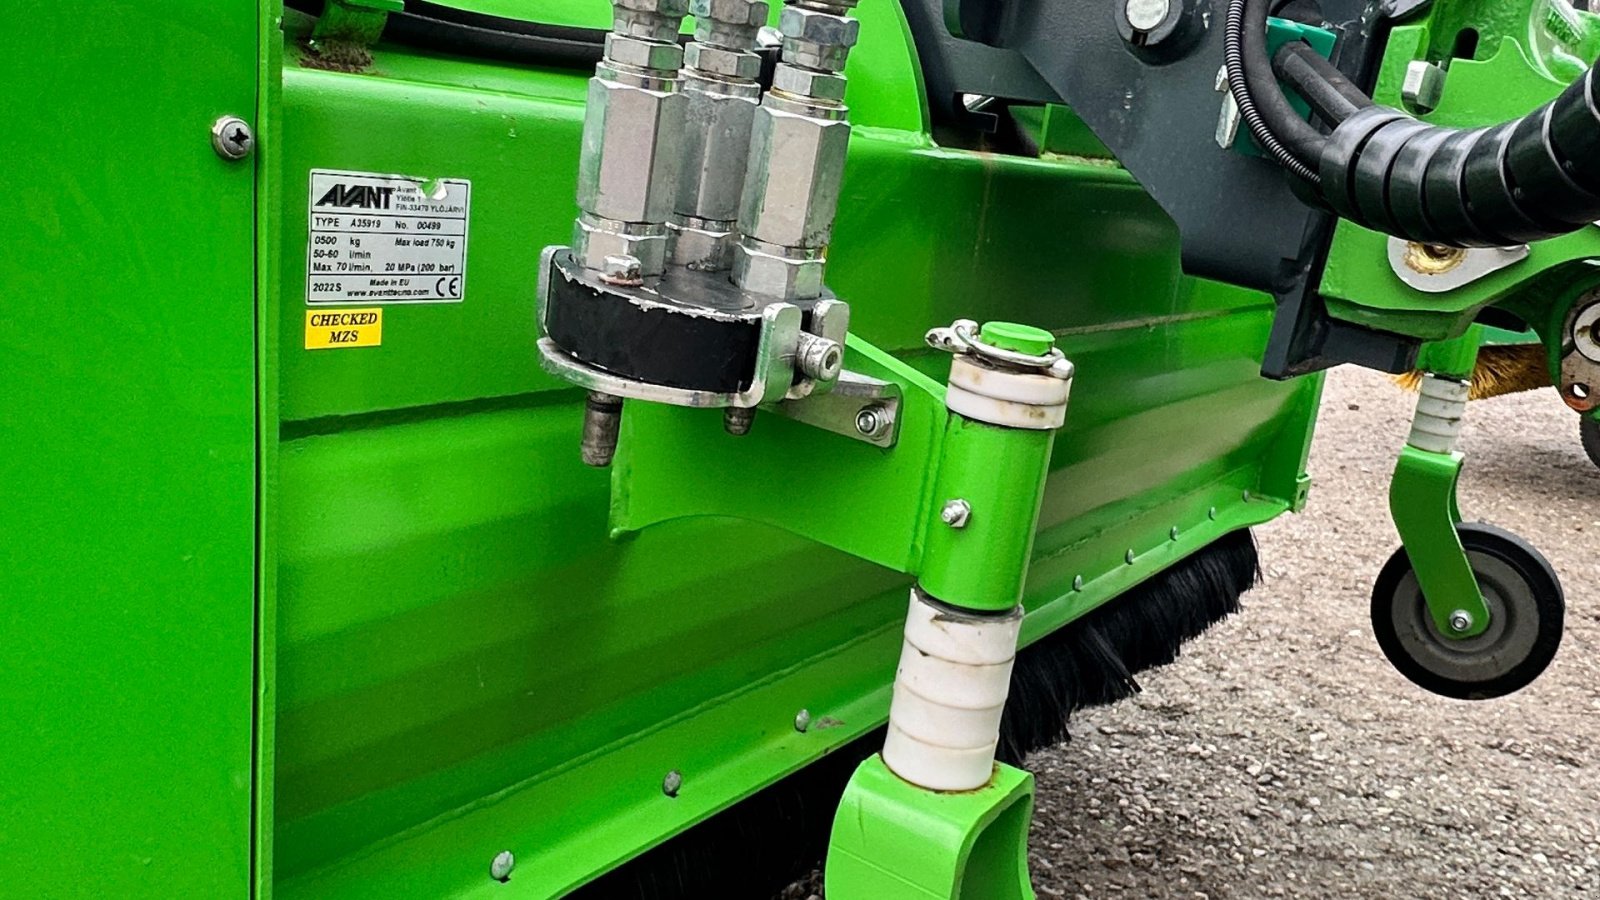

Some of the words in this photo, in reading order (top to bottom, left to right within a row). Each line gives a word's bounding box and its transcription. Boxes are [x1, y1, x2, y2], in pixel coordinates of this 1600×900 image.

[398, 185, 417, 194] Avant
[315, 183, 395, 210] AVANT
[315, 217, 340, 227] TYPE
[350, 218, 381, 228] A35919
[396, 220, 409, 230] No.
[417, 220, 441, 230] 00499
[315, 236, 337, 245] 0500
[350, 237, 361, 248] kg
[395, 237, 412, 246] Max
[413, 238, 430, 247] load
[431, 238, 445, 247] 750
[447, 238, 456, 249] kg
[314, 249, 339, 258] 50-60
[350, 250, 372, 259] l/min
[313, 262, 332, 271] Max
[337, 262, 348, 271] 70
[385, 263, 396, 272] 20
[398, 263, 415, 272] MPa
[418, 263, 435, 274] (200
[440, 263, 455, 274] bar)
[348, 288, 430, 297] www.avanttecno.com
[310, 312, 378, 327] CHECKED
[329, 330, 359, 343] MZS
